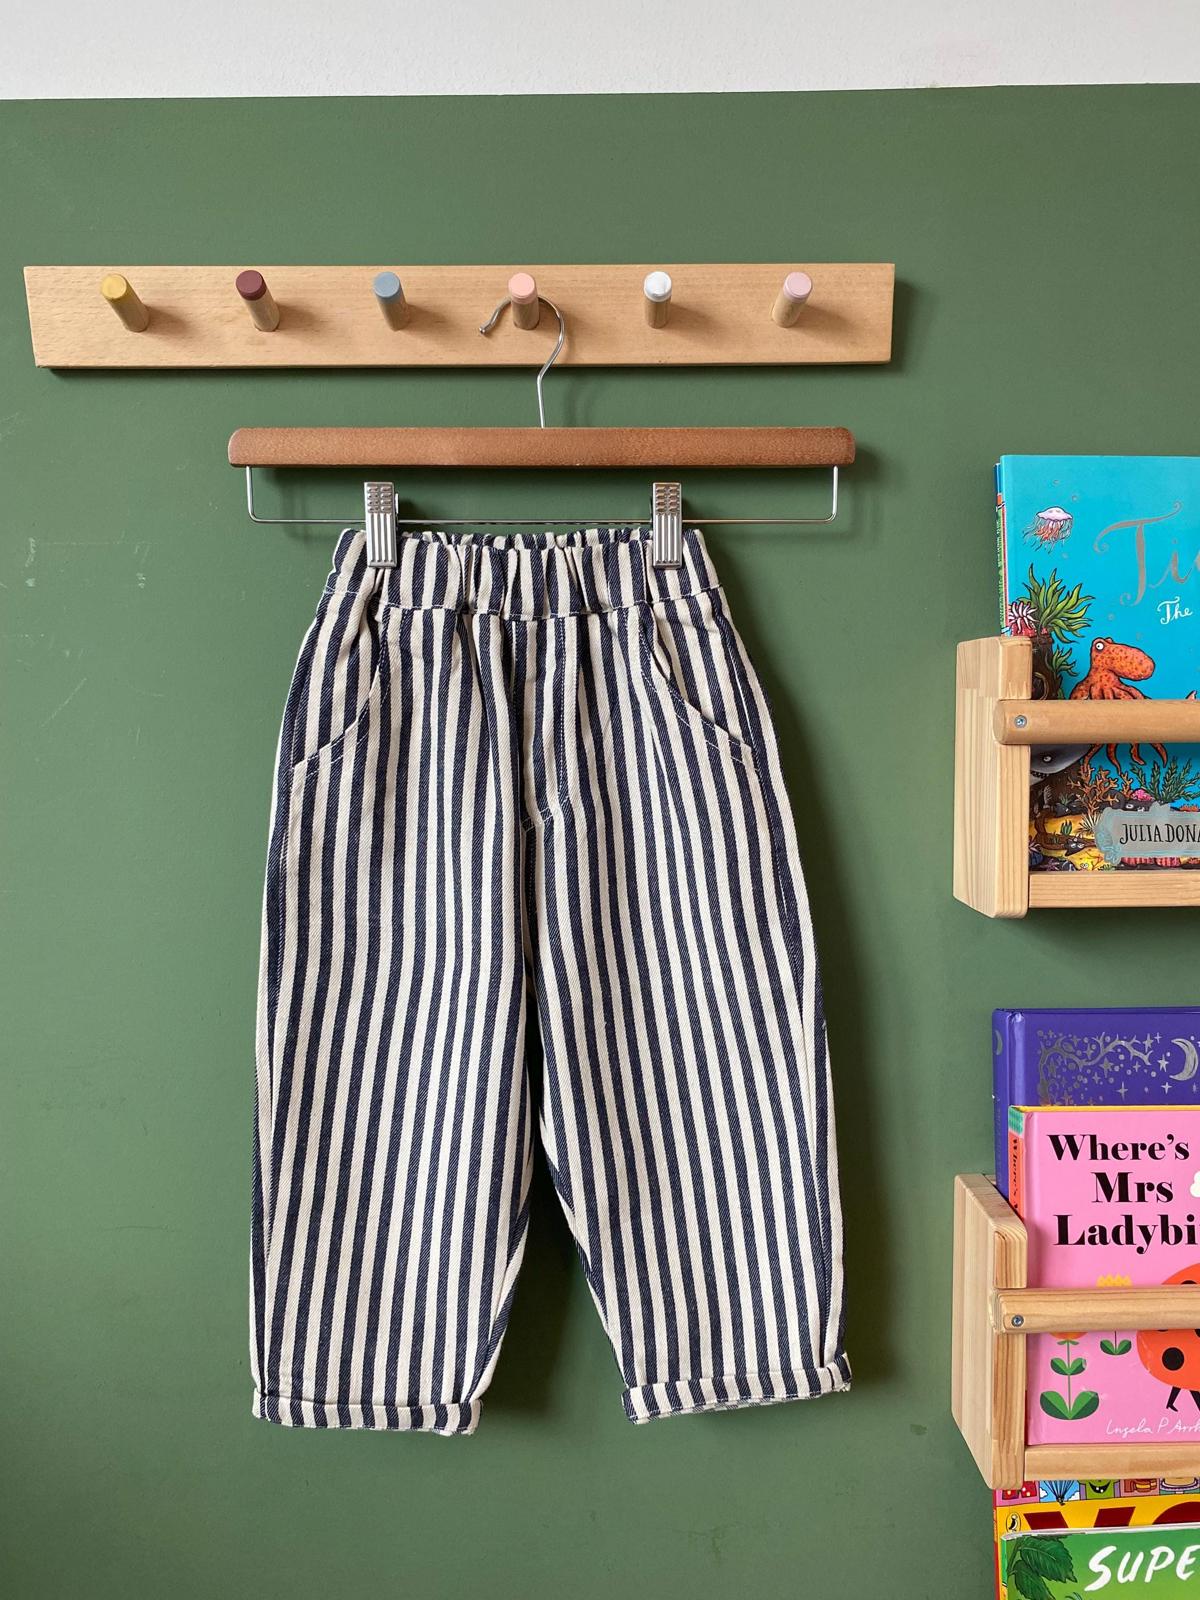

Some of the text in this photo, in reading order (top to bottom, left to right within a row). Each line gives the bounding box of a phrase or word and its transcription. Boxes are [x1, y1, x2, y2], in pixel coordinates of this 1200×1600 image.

[1093, 500, 1200, 606] Ti
[1157, 596, 1193, 625] The
[1120, 823, 1163, 844] JULIA
[1046, 1133, 1190, 1161] Where's
[1091, 1171, 1174, 1203] Mrs
[1053, 1213, 1200, 1255] Ladybi
[1157, 1417, 1169, 1433] P
[1084, 1544, 1200, 1592] SUPE
